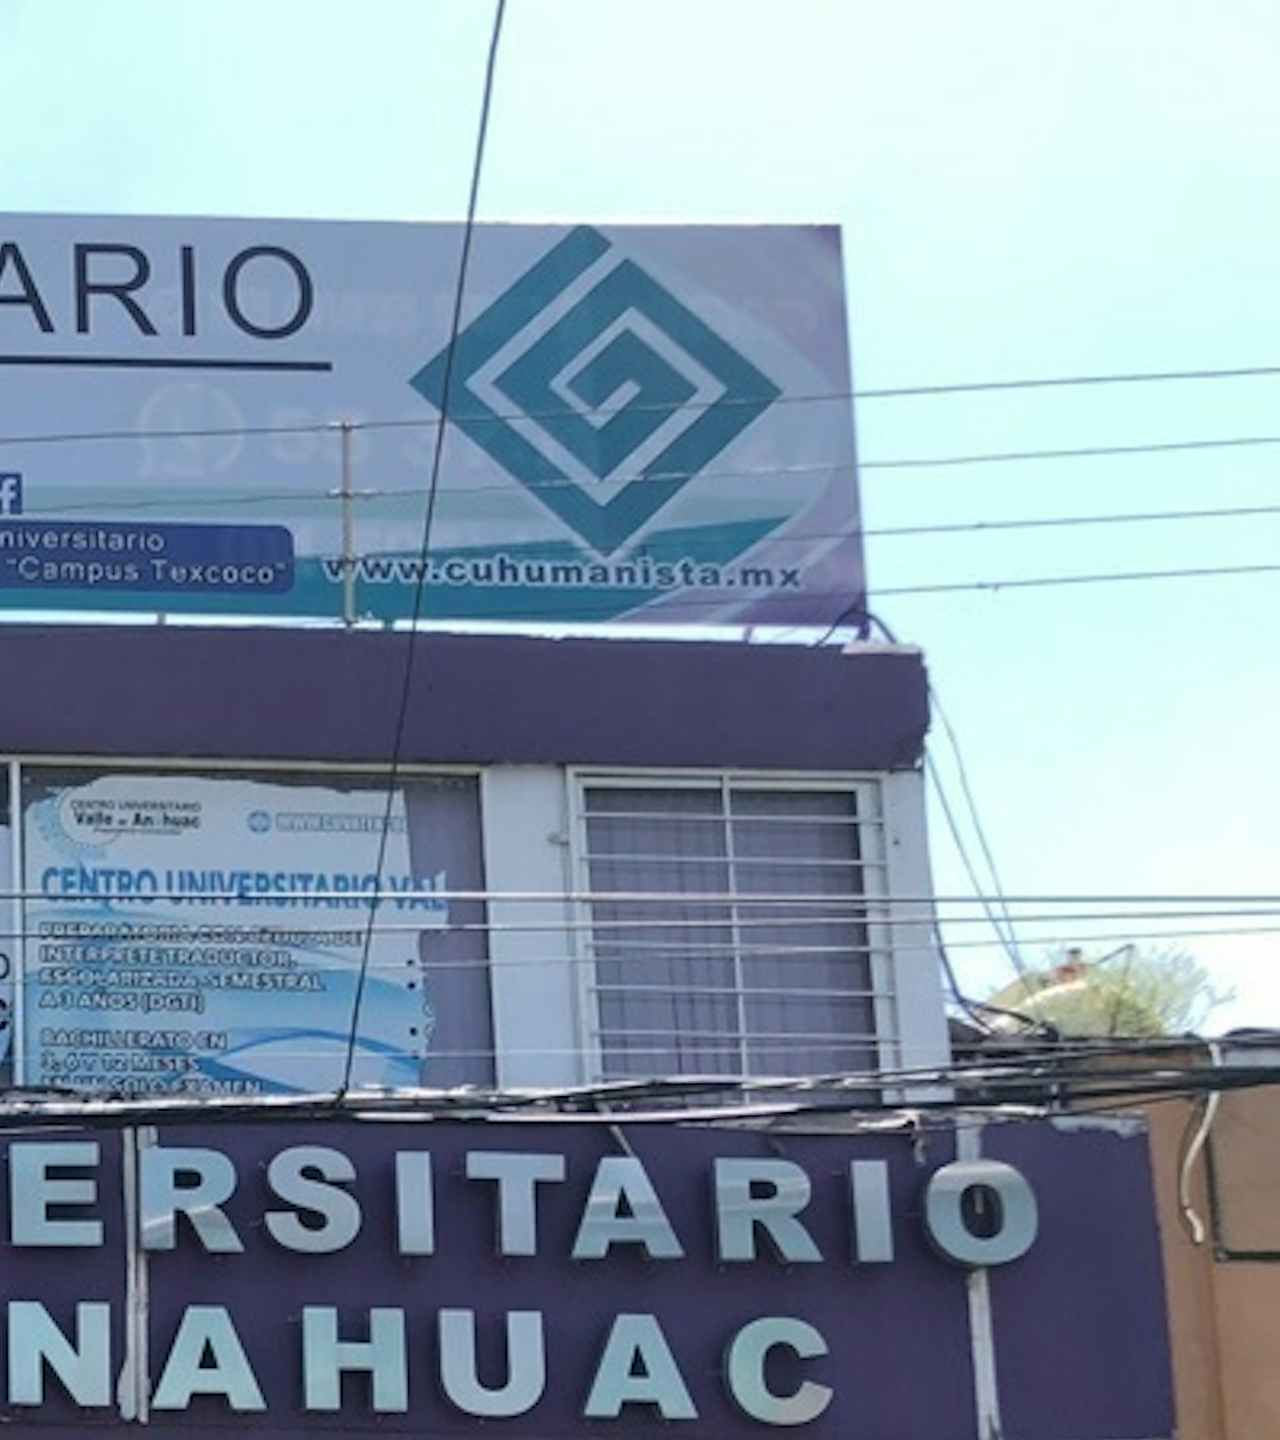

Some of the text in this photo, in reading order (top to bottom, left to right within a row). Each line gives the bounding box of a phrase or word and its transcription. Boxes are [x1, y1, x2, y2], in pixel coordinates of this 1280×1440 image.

[323, 553, 802, 590] www.cuhumanista.mx
[41, 866, 158, 906] CENTRO
[167, 870, 379, 911] UNIVERSITARIO
